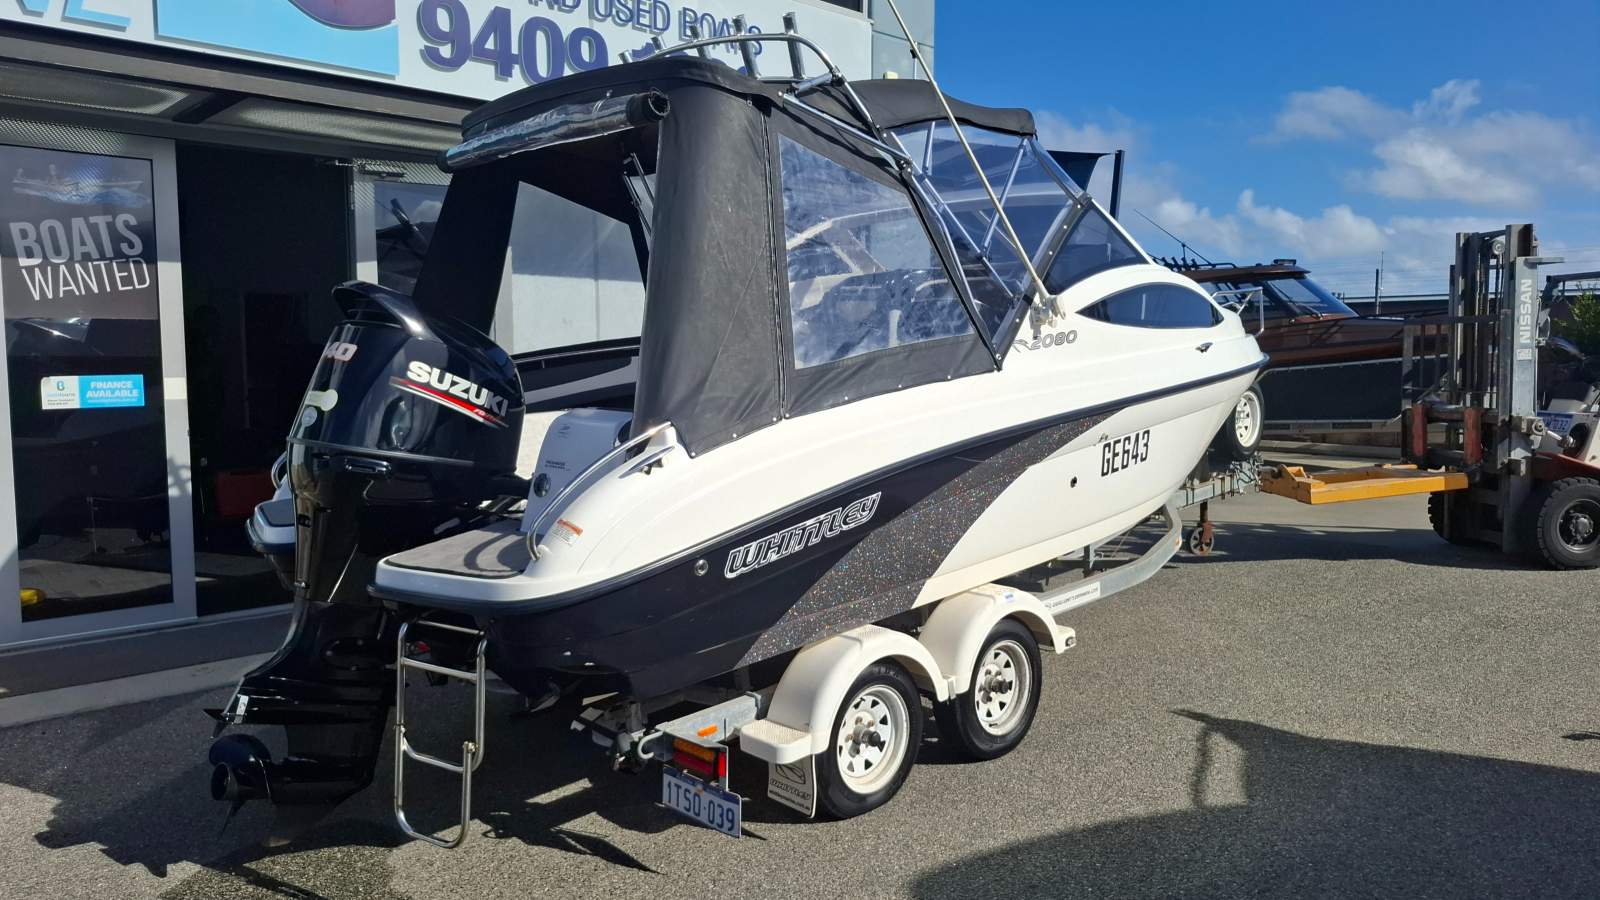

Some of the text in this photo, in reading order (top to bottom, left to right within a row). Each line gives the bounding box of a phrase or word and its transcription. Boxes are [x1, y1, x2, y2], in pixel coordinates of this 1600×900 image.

[9, 213, 144, 267] BOATS
[21, 257, 150, 301] WANTED
[1519, 278, 1533, 344] NISSAN
[86, 388, 140, 399] AVAILABLE
[90, 380, 134, 389] FINANCE
[406, 360, 509, 417] SUZUKI
[1101, 429, 1151, 477] GE643
[724, 491, 882, 579] WHITTLEY
